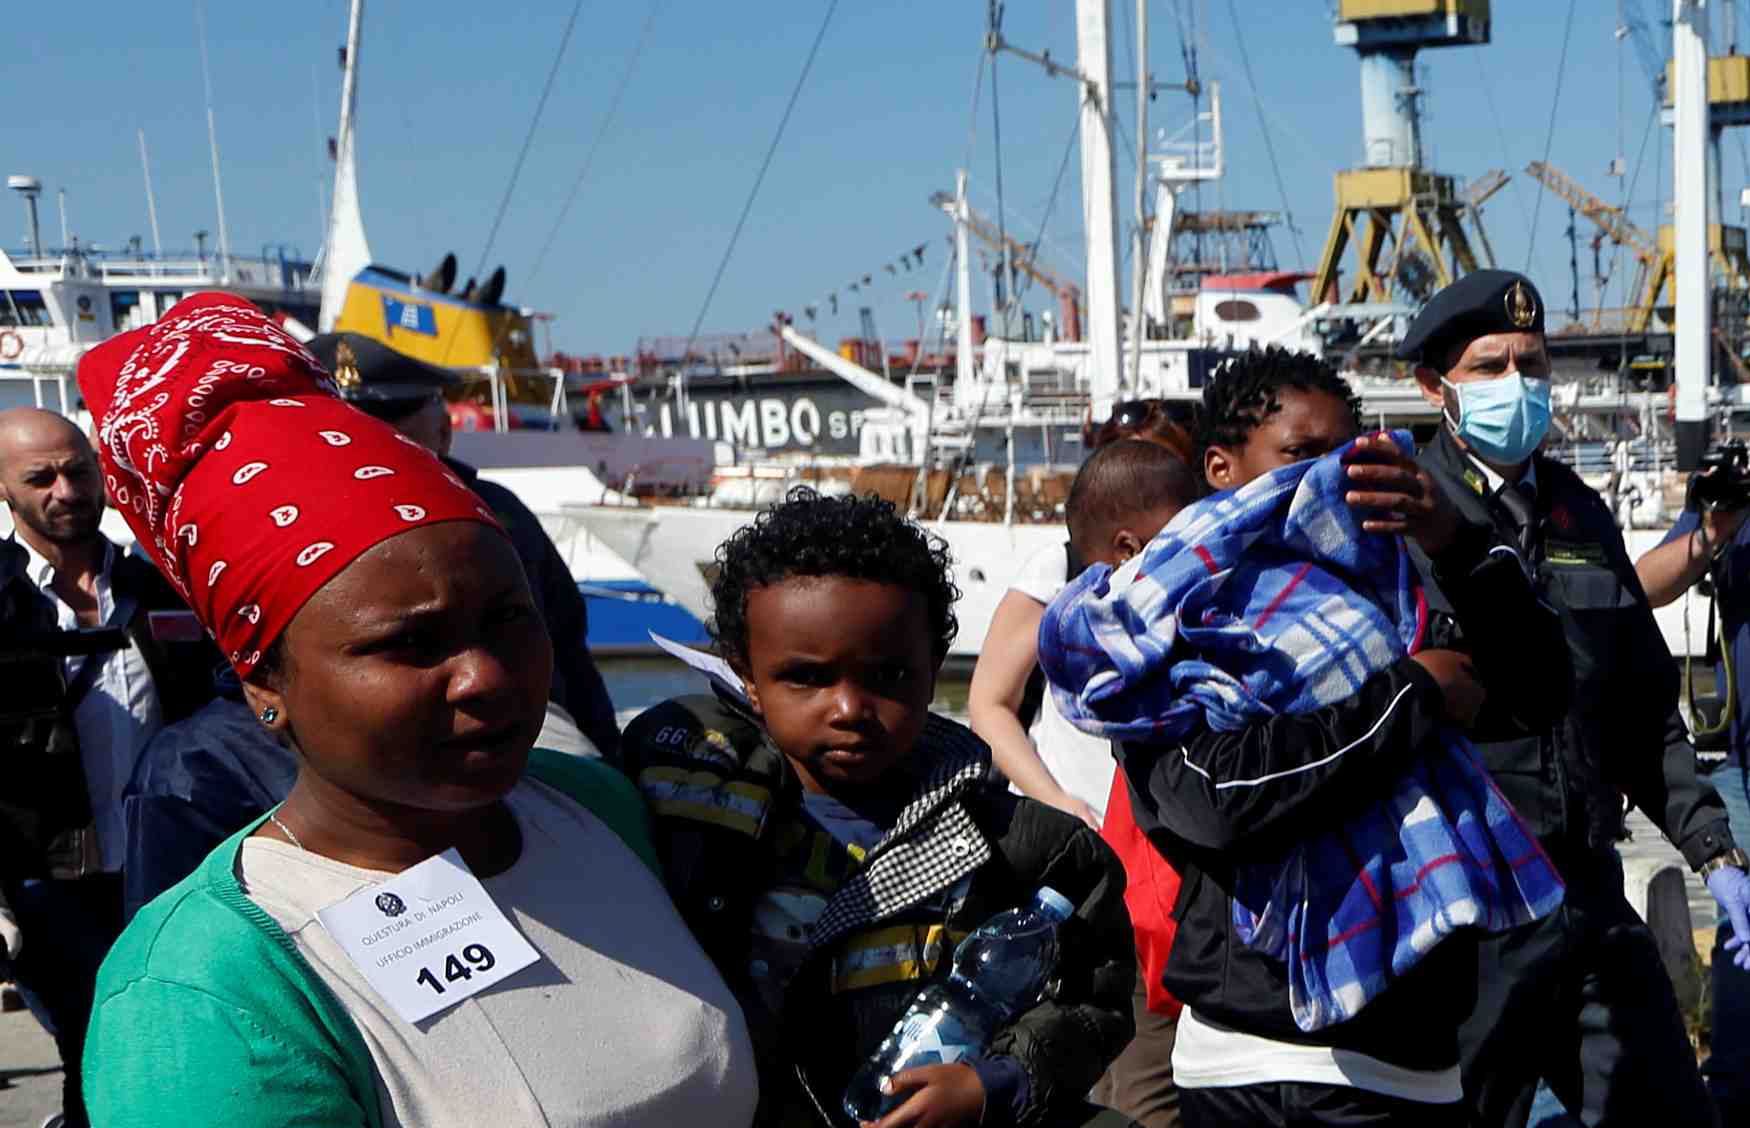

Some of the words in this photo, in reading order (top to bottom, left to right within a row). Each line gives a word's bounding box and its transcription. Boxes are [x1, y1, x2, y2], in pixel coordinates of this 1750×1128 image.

[361, 917, 412, 946] QUESTURA
[414, 911, 427, 922] DI
[430, 892, 465, 916] NAPOLI
[376, 945, 413, 968] UFFICIO
[414, 912, 482, 950] IMMIGRAZIONE
[416, 943, 496, 994] 149
